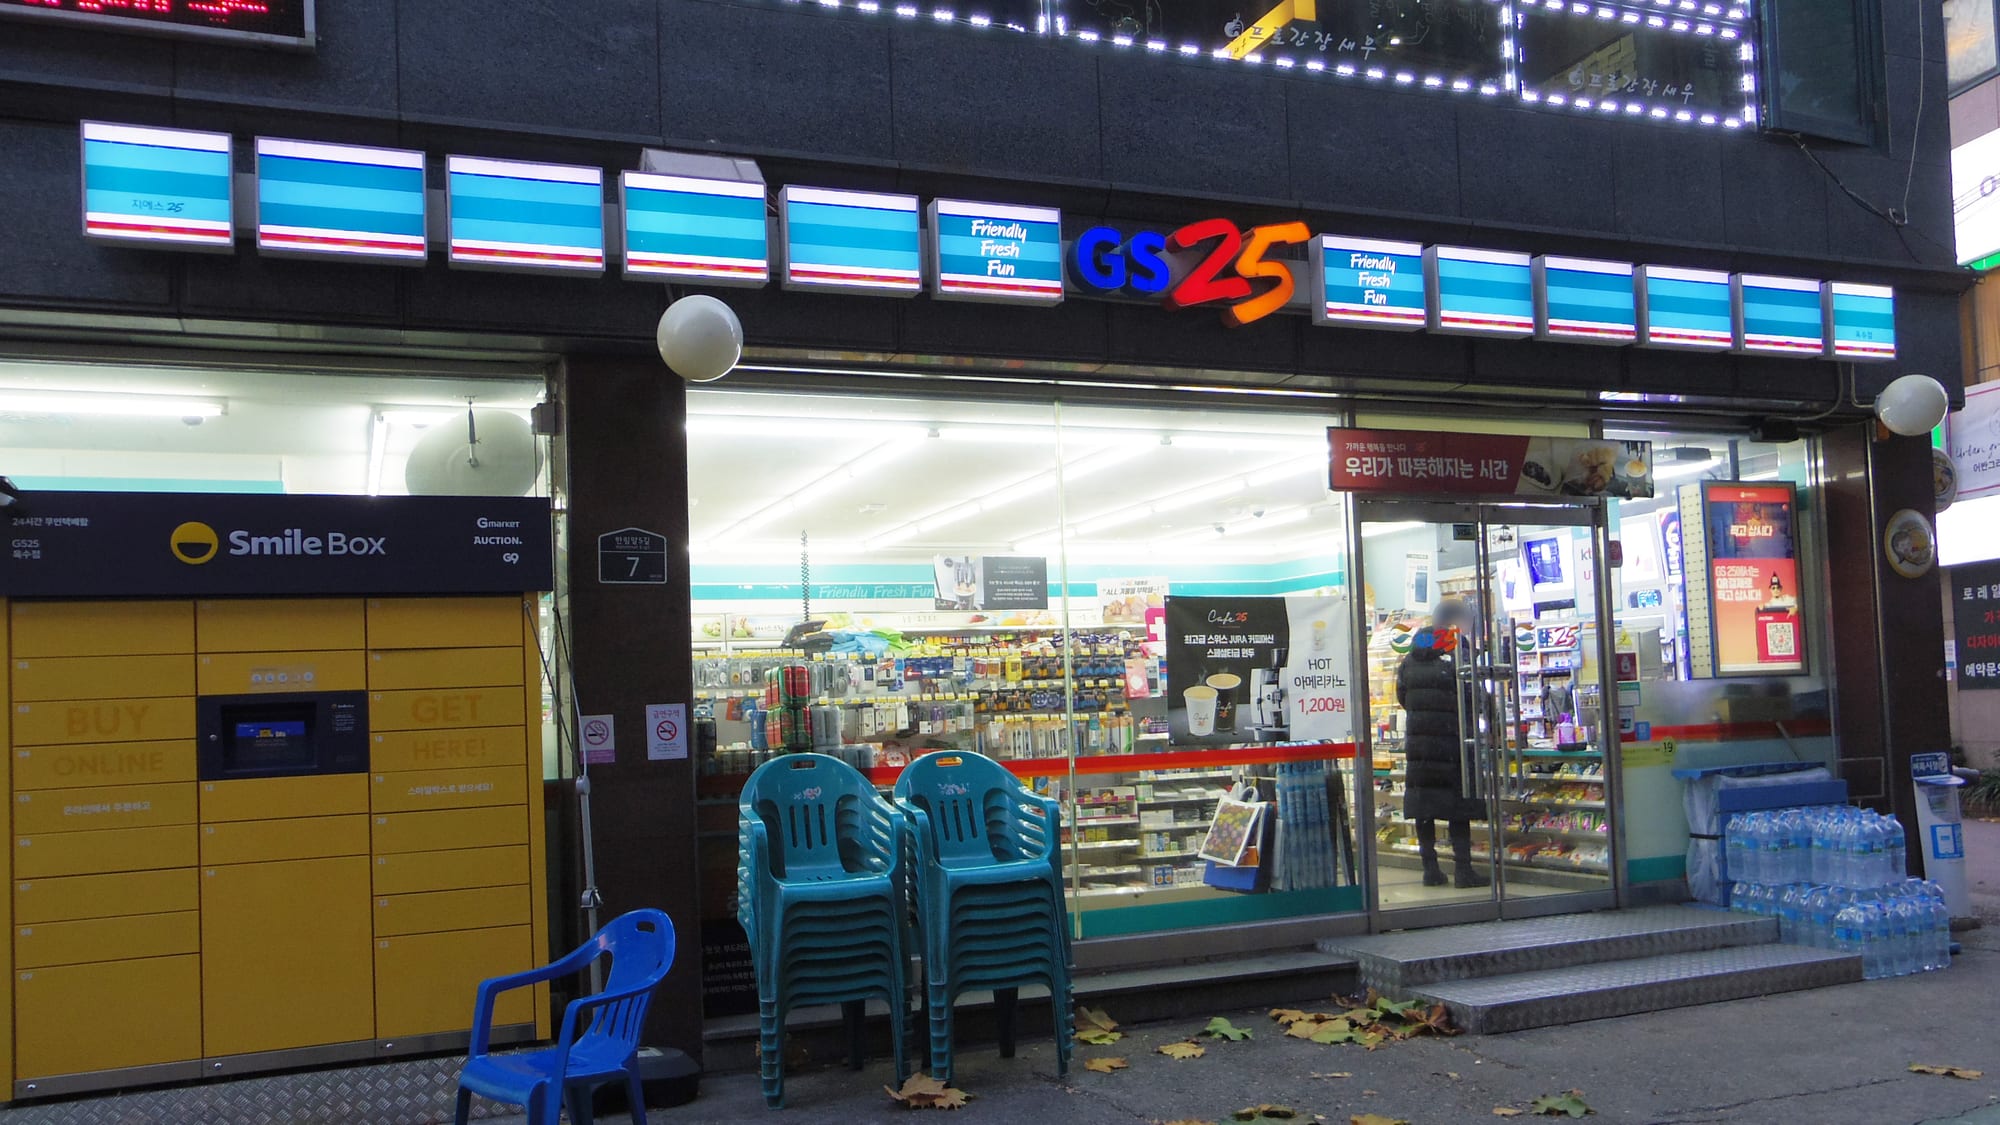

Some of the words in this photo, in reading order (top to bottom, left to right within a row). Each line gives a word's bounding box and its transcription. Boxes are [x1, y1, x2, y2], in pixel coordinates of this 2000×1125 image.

[132, 199, 163, 210] 지에스
[167, 202, 184, 213] 25
[971, 219, 1028, 244] Friendly
[980, 239, 1021, 259] Fresh
[987, 259, 1015, 276] Fun
[1070, 217, 1312, 326] GS25
[1350, 252, 1396, 275] Friendly
[1358, 271, 1391, 288] Fresh
[1363, 289, 1387, 305] Fun
[1345, 456, 1393, 478] 우리가
[1397, 456, 1474, 479] 따뜻해지는
[1479, 458, 1508, 480] 시간
[12, 539, 39, 548] GS25
[228, 528, 322, 556] Smile
[328, 532, 386, 556] Box
[502, 552, 519, 565] G9
[626, 556, 640, 577] 7
[818, 585, 869, 599] Friendly
[873, 586, 906, 598] Fresh
[911, 586, 934, 598] Fun
[1207, 609, 1236, 625] Cafe
[1235, 611, 1248, 623] 25
[1183, 634, 1206, 645] 최고급
[1206, 634, 1228, 645] 스위스
[1229, 634, 1247, 644] JURA
[1248, 634, 1274, 645] 커피머신
[1967, 635, 2000, 649] 디자이
[1308, 658, 1333, 671] HOT
[1294, 675, 1347, 690] 아메리카노
[411, 693, 482, 723] GET
[1298, 697, 1346, 716] 1,200원
[66, 705, 149, 737] BUY
[413, 738, 486, 761] HERE!
[1663, 742, 1674, 753] 19
[53, 751, 164, 776] ONLINE
[407, 784, 456, 796] 스마일박스로
